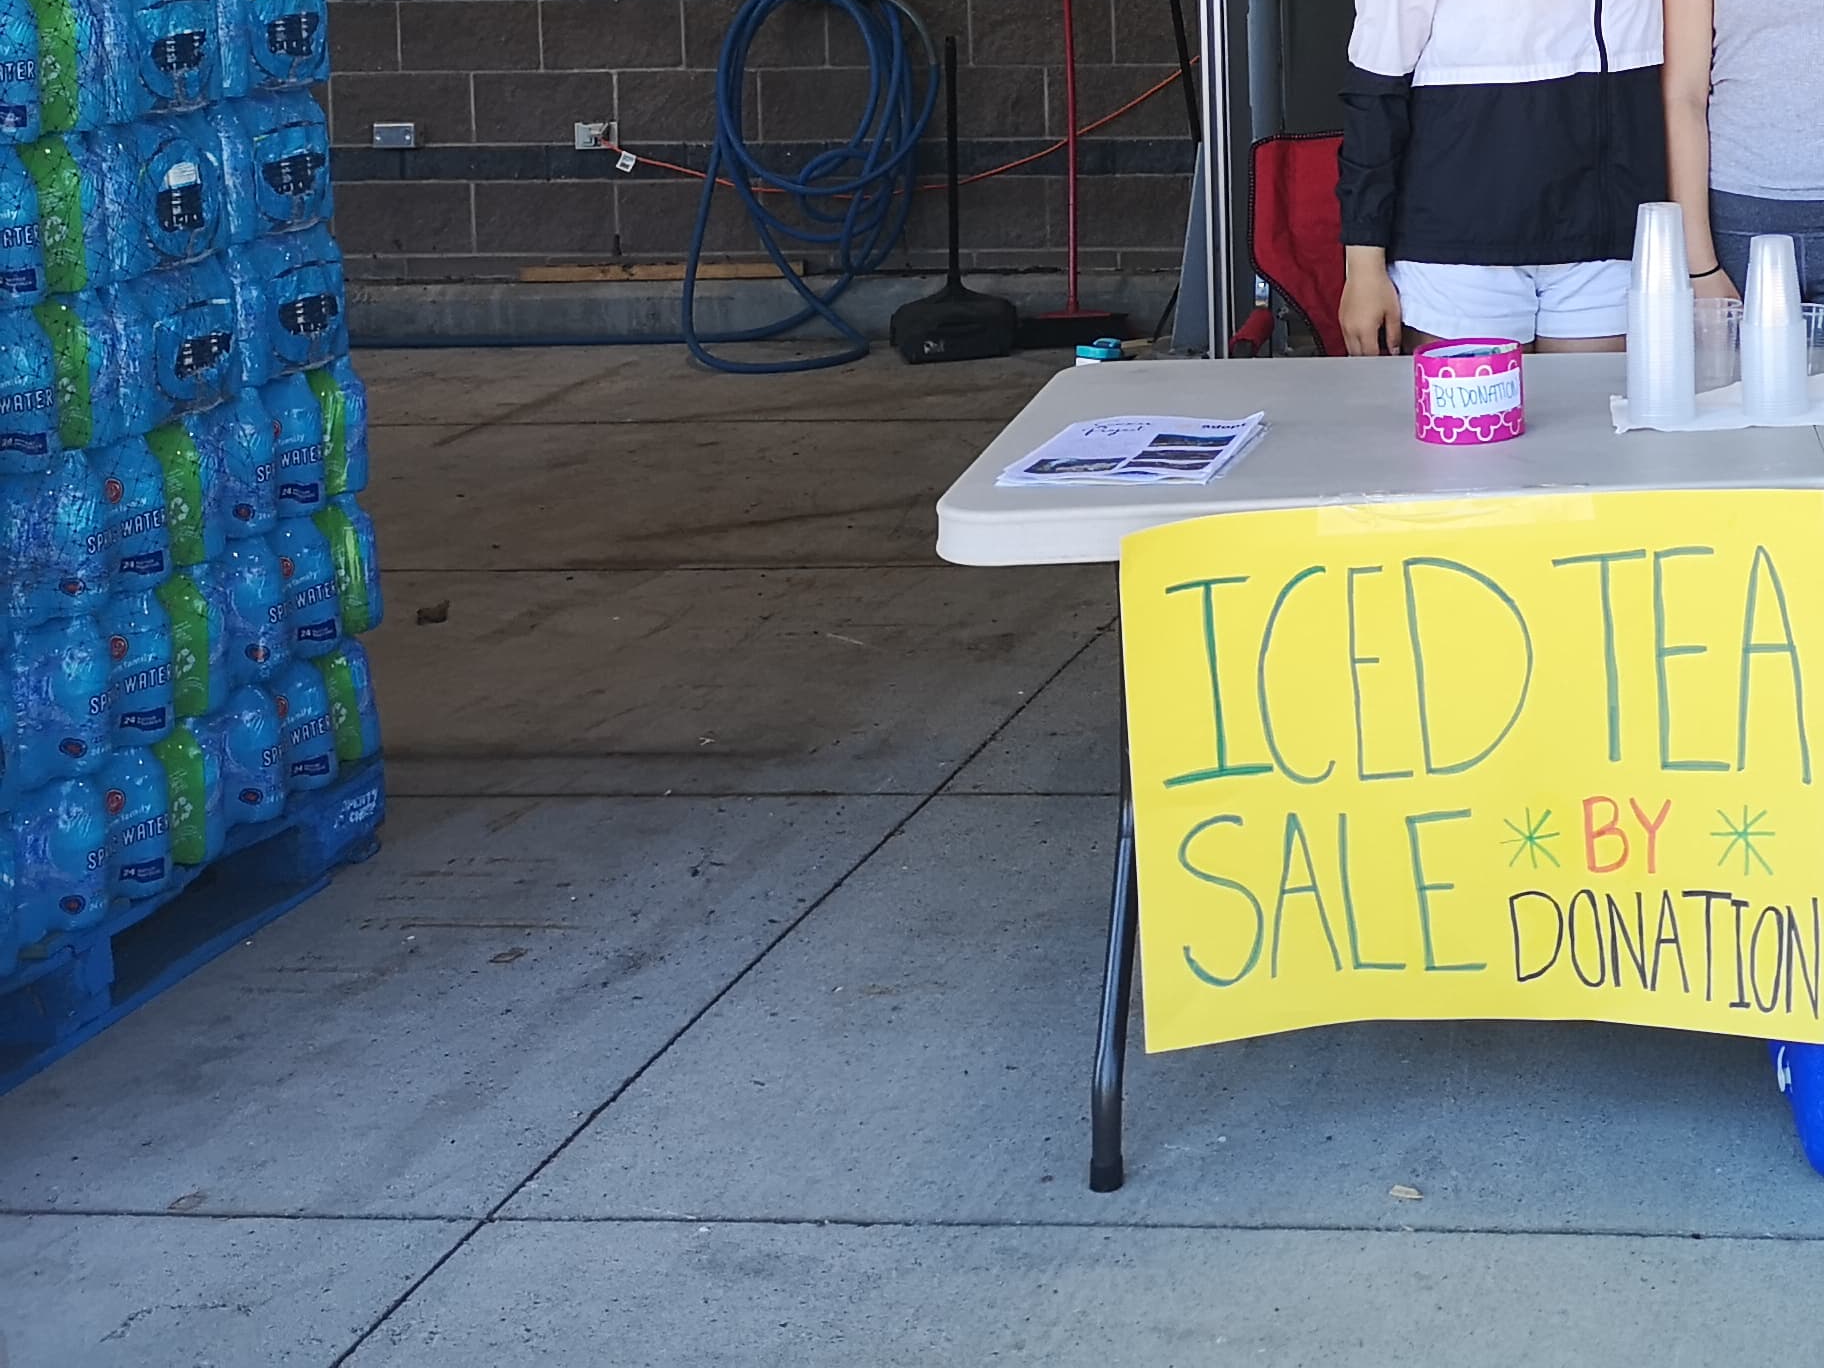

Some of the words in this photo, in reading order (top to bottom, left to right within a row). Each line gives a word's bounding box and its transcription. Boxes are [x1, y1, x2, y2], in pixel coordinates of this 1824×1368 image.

[1432, 383, 1456, 409] BY
[1164, 557, 1534, 788] ICED
[1552, 544, 1813, 785] TEA
[1178, 808, 1488, 988] SALE
[1581, 795, 1672, 876] BY
[1508, 888, 1820, 1021] DONATION
